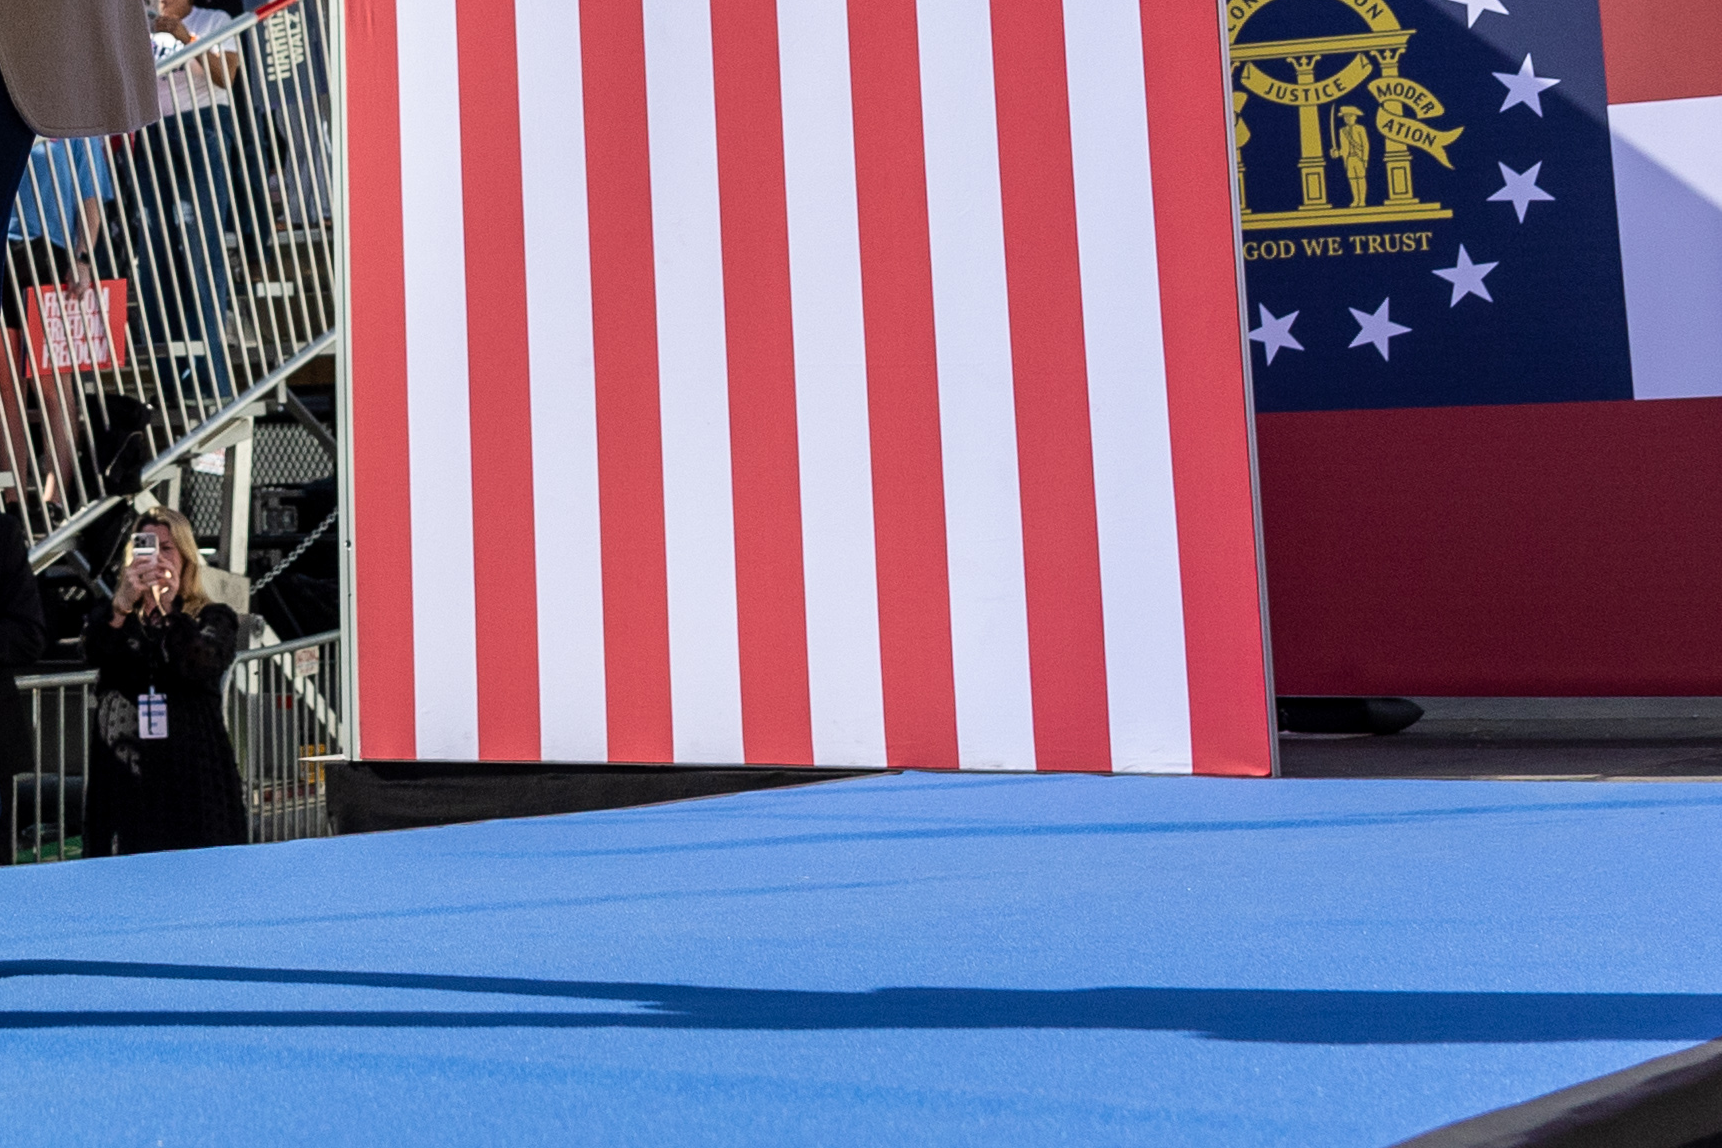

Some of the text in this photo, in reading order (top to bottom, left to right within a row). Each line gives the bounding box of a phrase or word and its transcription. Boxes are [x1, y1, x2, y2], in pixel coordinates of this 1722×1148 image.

[1264, 78, 1346, 102] JUSTICE
[1377, 81, 1435, 114] MODER
[1382, 118, 1437, 147] ATION
[1243, 232, 1432, 260] GOD WE TRUST
